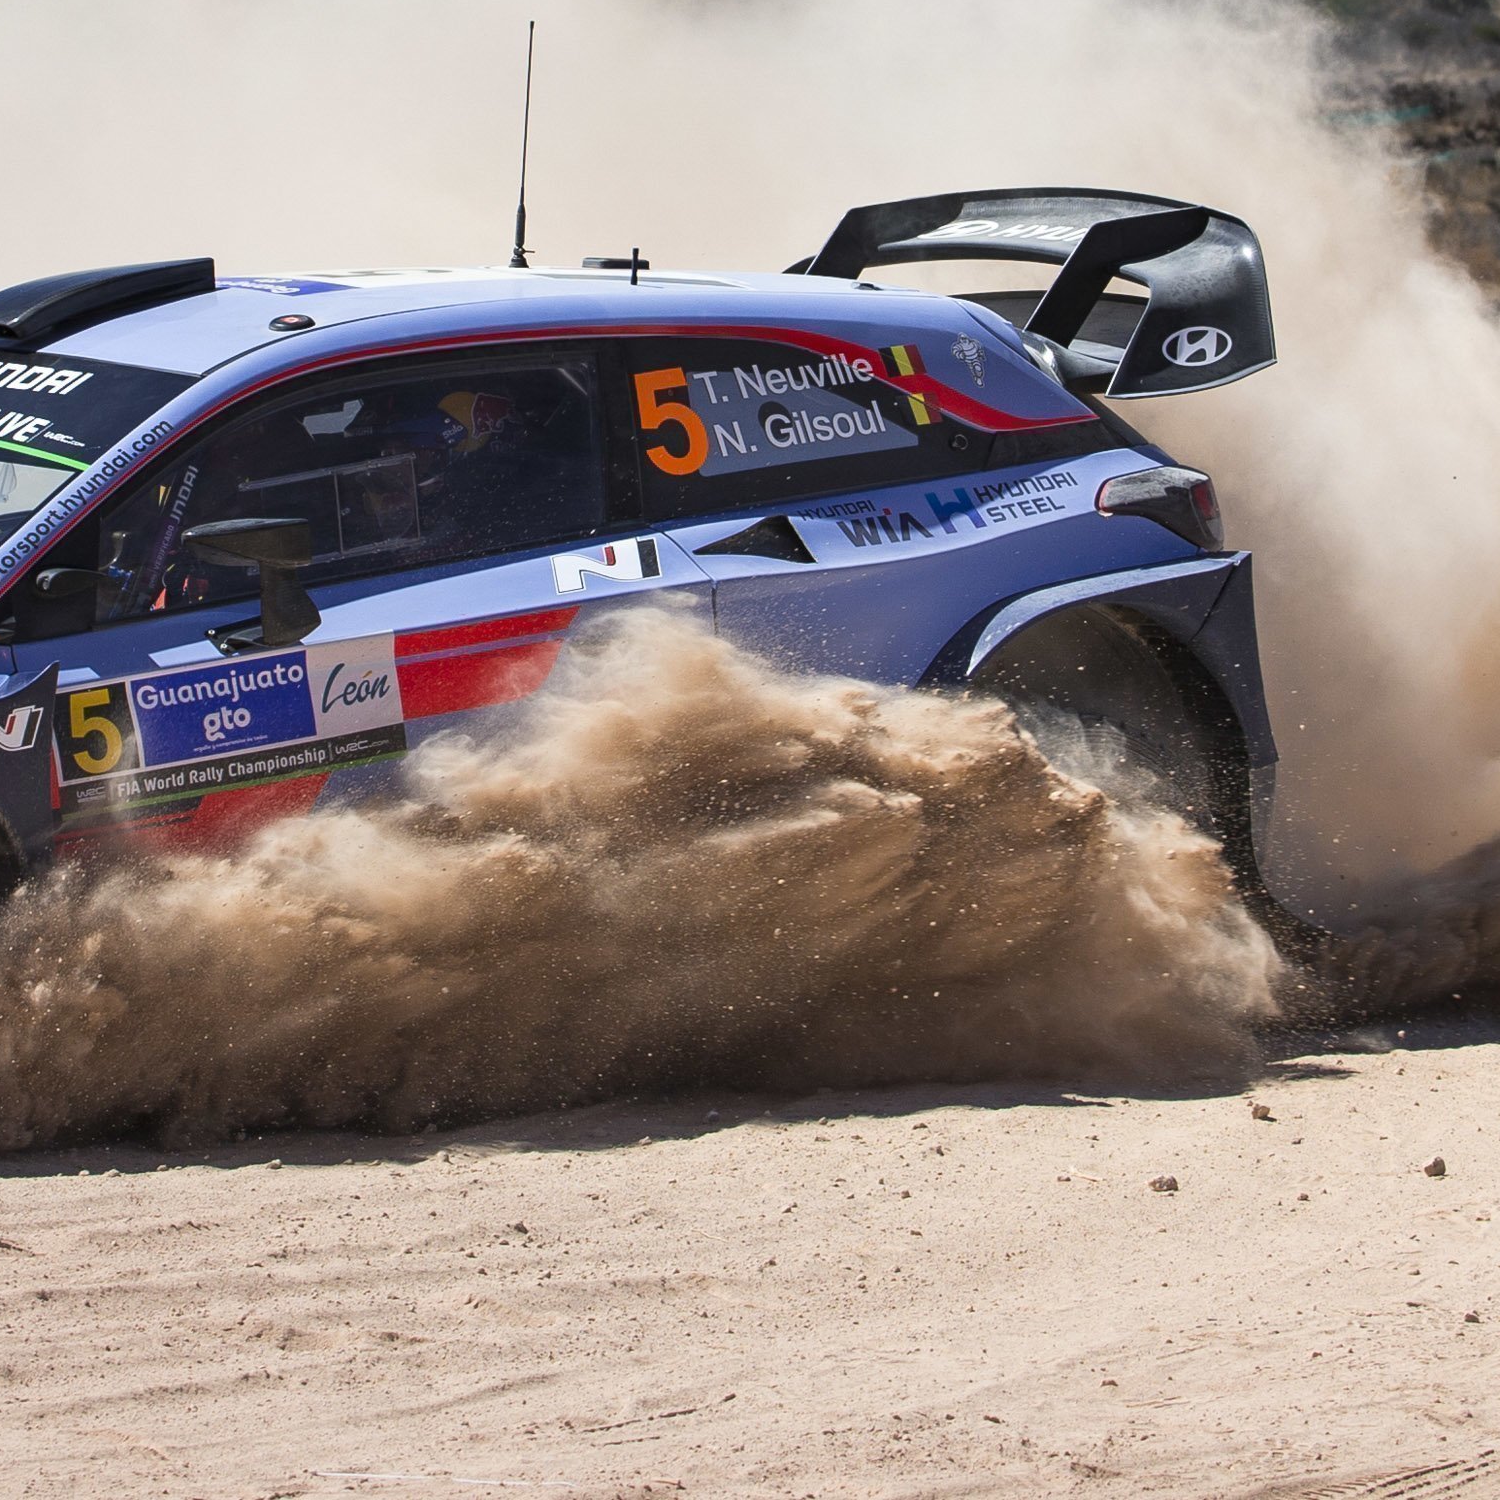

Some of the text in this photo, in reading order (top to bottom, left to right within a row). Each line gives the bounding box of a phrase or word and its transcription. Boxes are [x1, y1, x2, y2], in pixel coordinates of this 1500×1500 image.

[693, 353, 874, 405] T. Neuville
[634, 367, 709, 476] 5
[713, 400, 887, 457] N. Gilsoul
[799, 499, 876, 522] HYUNDAI
[973, 471, 1078, 504] HYUNDAI
[986, 496, 1065, 523] STEEL
[836, 508, 933, 547] WIA
[136, 663, 304, 711] Guanajuato
[321, 663, 390, 714] León
[69, 688, 123, 775] 5
[203, 707, 251, 742] gto
[117, 776, 141, 798] FIA
[143, 771, 185, 794] World
[189, 765, 223, 787] Rally
[228, 748, 326, 778] Championship
